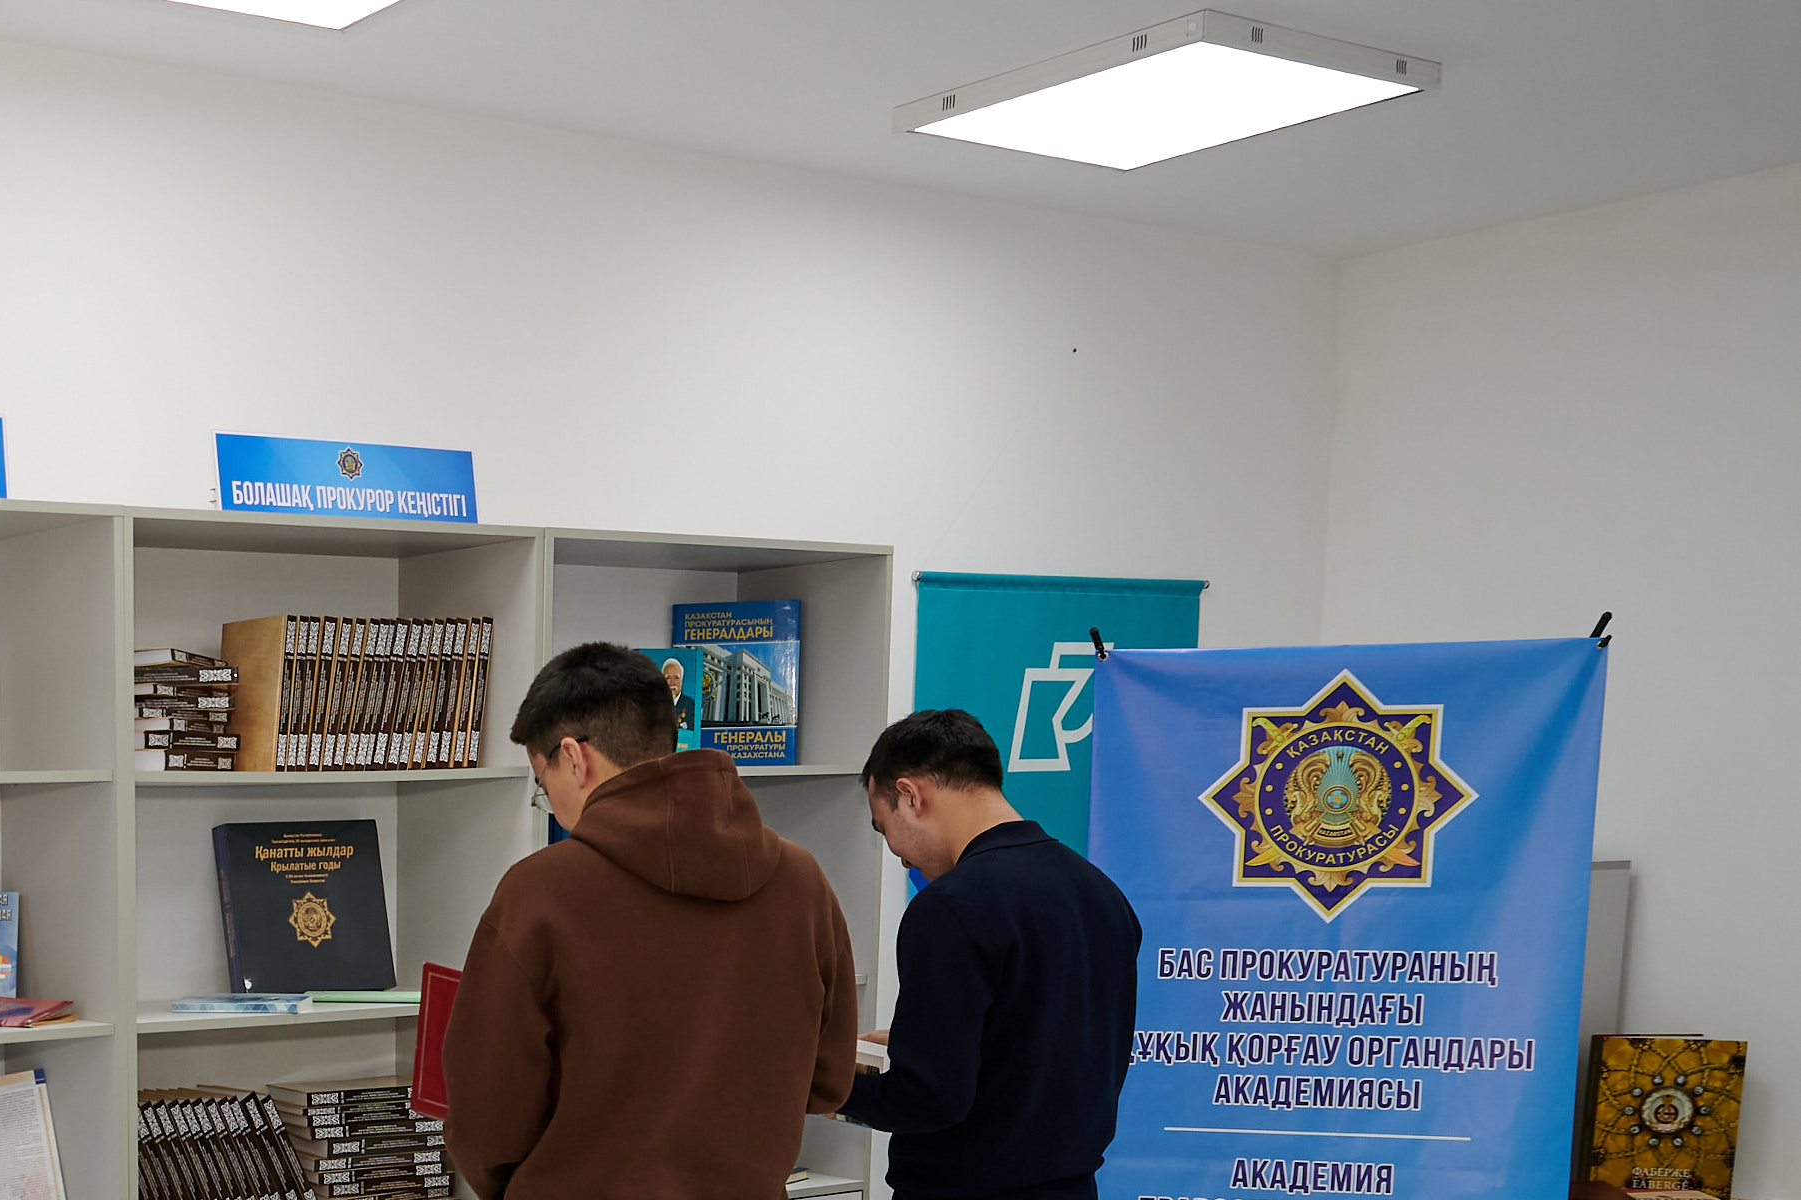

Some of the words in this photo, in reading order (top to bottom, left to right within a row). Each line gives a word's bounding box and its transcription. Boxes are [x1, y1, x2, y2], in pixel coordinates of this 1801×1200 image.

[231, 480, 314, 511] БОЛАШАҚ
[316, 485, 394, 512] ПРОКУРОР
[397, 491, 467, 517] КЕҢІСТІГІ
[684, 626, 773, 640] ГЕНЕРАЛДАРЫ
[714, 731, 786, 744] ГЕНЕРАЛЫ
[727, 743, 785, 751] ПРОКУРАТУРЫ
[1286, 728, 1390, 759] ҚАЗАҚСТАН
[255, 845, 304, 861] Қанатты
[306, 845, 354, 859] жылдар
[1270, 823, 1400, 866] ПРОКУРАТУРАСЫ
[270, 861, 316, 874] Крылатые
[318, 861, 341, 872] годы
[1157, 948, 1213, 980] БАС
[1218, 949, 1497, 987] ПРОКУРАТУРАНЫҢ
[1220, 990, 1424, 1027] ЖАНЫНДАҒЫ
[1128, 1030, 1219, 1066] ҰҚЫҚ
[1224, 1032, 1341, 1067] ҚОРҒАУ
[1347, 1035, 1535, 1072] ОРГАНДАРЫ
[1212, 1075, 1422, 1111] АКАДЕМИЯСЫ
[1230, 1158, 1394, 1195] АКАДЕМИЯ
[1632, 1166, 1691, 1178] ФАБЕРЖЕ
